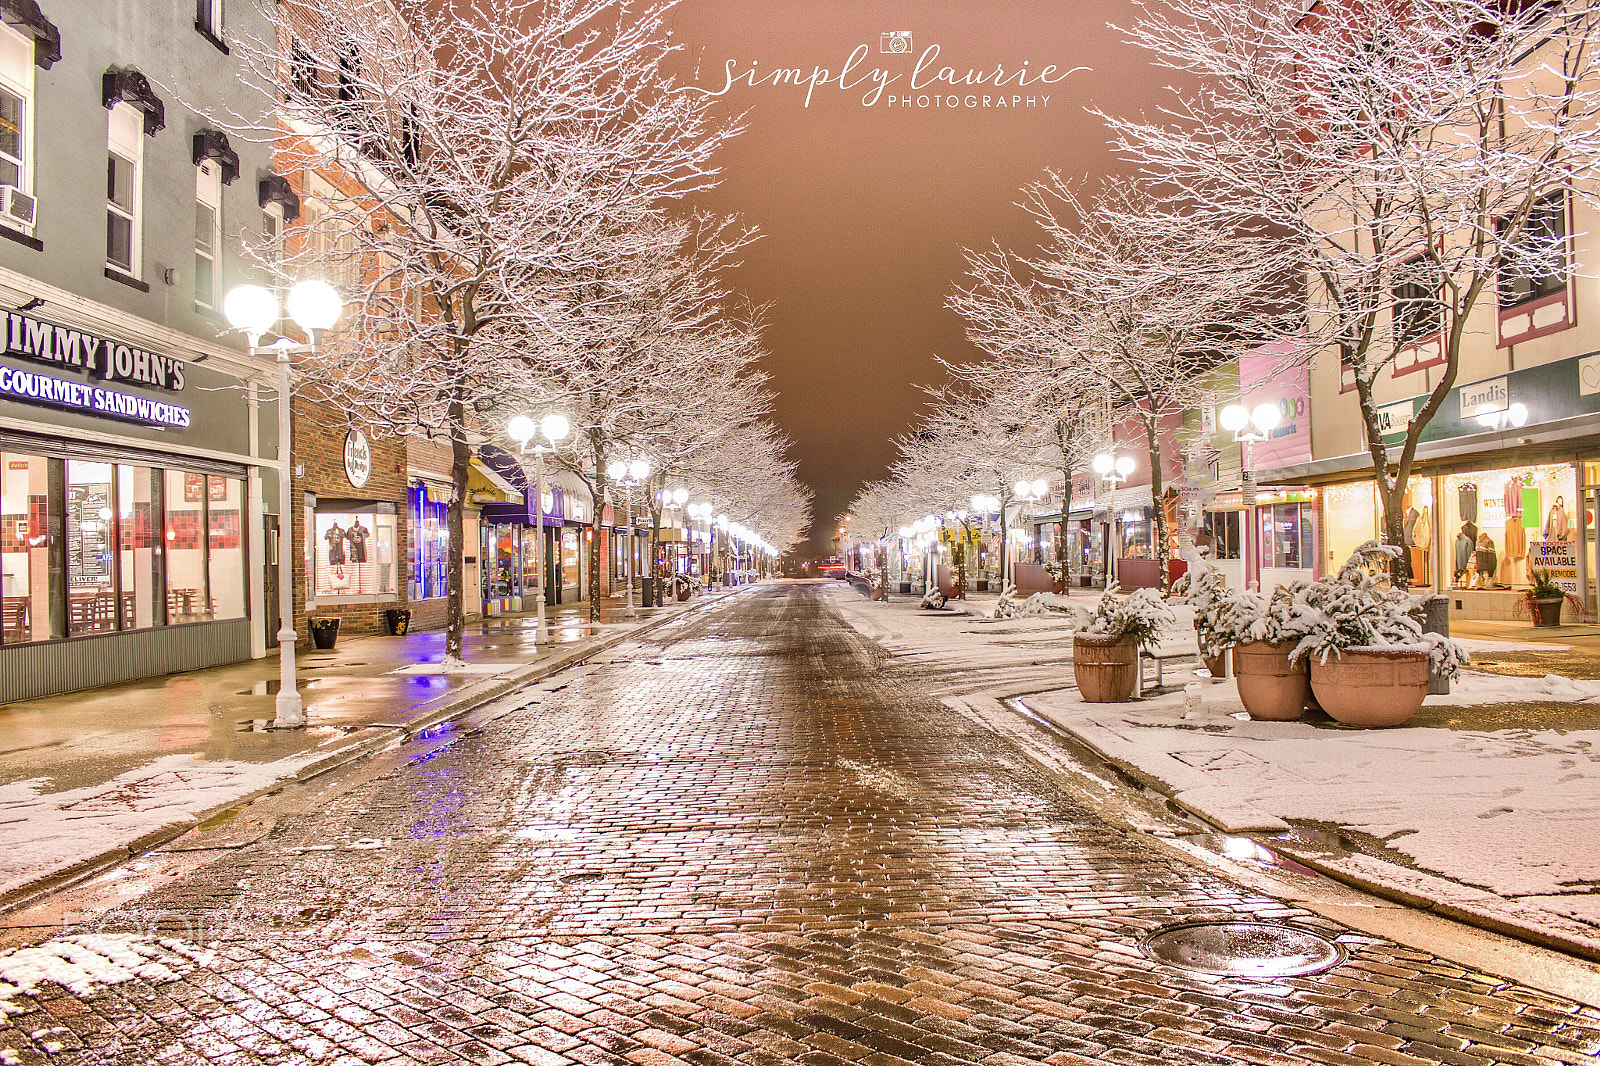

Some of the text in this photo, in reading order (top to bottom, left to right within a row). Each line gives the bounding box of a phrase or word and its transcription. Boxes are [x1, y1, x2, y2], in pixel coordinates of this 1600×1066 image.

[0, 309, 185, 391] JIMMY JOHN'S
[0, 366, 190, 427] GOURMET SANDWICHES
[1461, 385, 1506, 407] Landis
[1483, 498, 1505, 507] WINTE
[1540, 546, 1567, 556] SPACE
[1534, 556, 1576, 566] AVAILABLE
[1551, 570, 1577, 578] REMODEL
